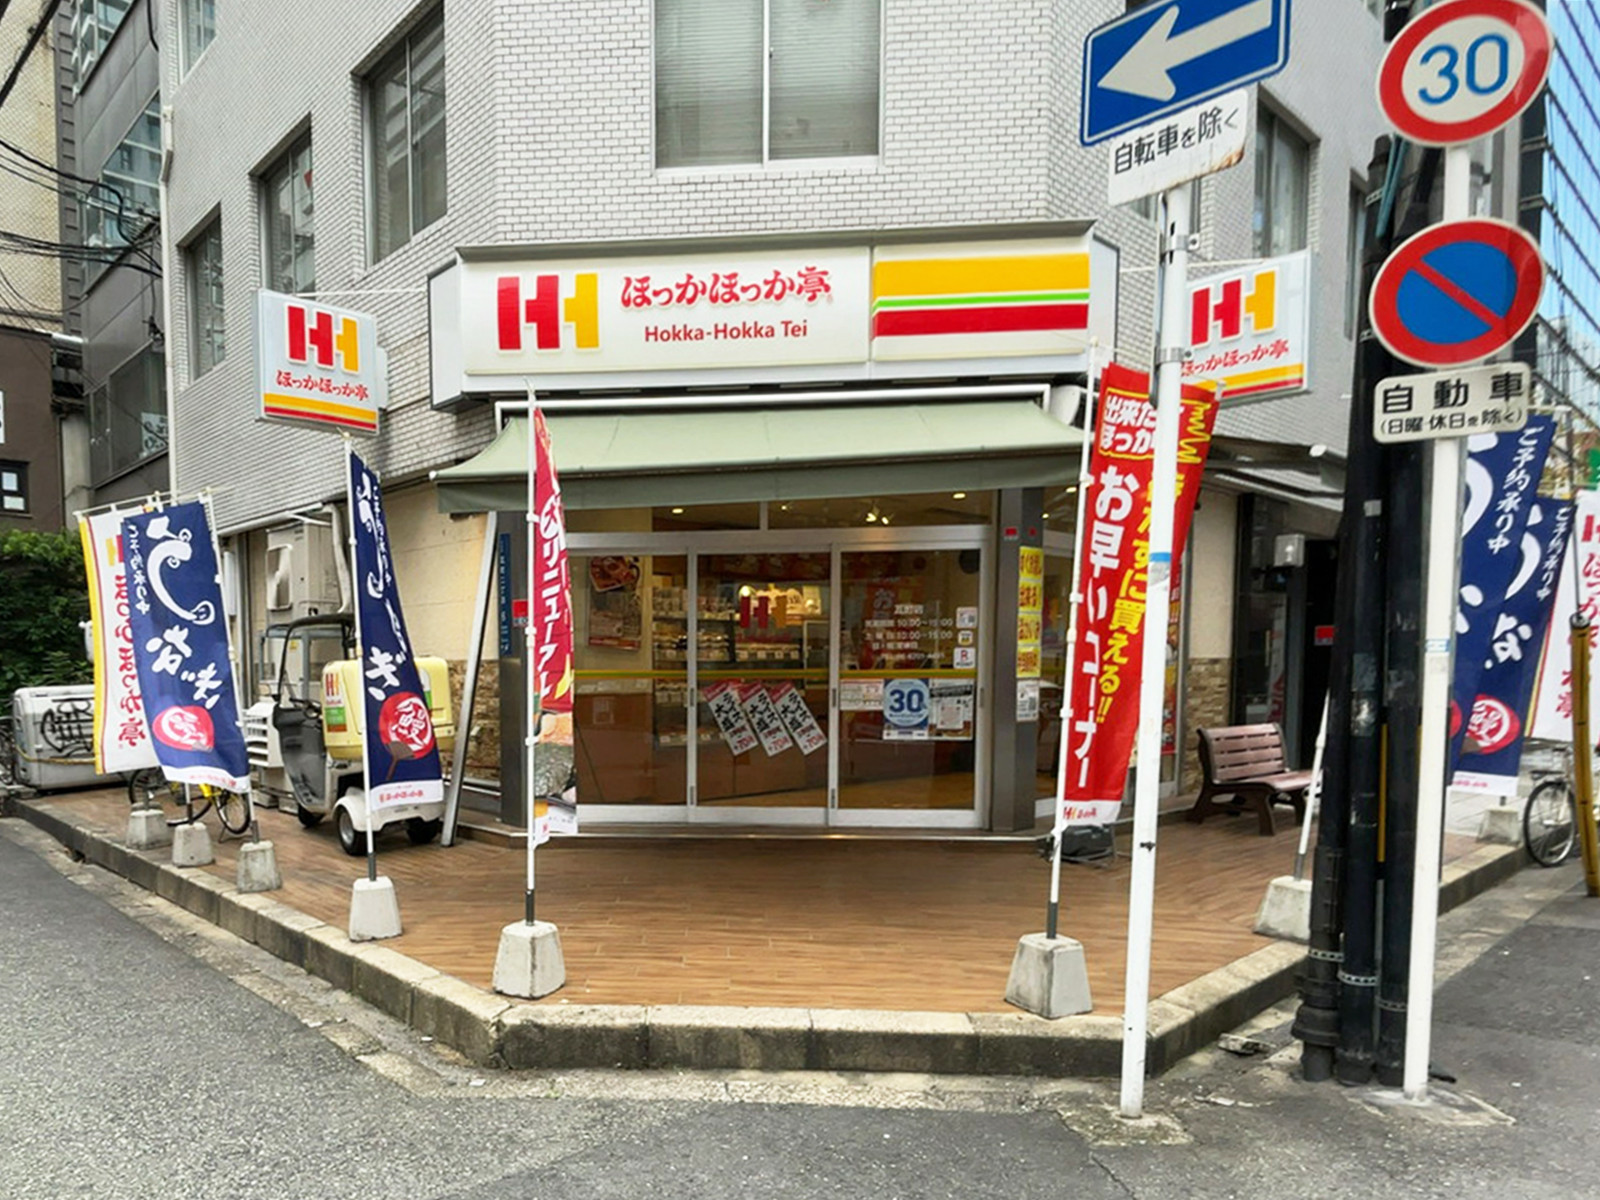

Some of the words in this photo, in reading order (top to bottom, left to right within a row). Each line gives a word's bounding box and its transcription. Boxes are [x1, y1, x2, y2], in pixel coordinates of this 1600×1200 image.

[1418, 33, 1509, 106] 30
[1114, 106, 1239, 175] 自転車を除く
[621, 266, 831, 308] ほっかほっか亭
[644, 323, 775, 342] Hokka-Hokka
[781, 320, 808, 337] Tei
[276, 369, 370, 402] ほっかほっか亭
[1383, 371, 1524, 414] 自動車
[1487, 425, 1545, 555] ご予約承り中
[1074, 464, 1138, 788] お早いコーナー
